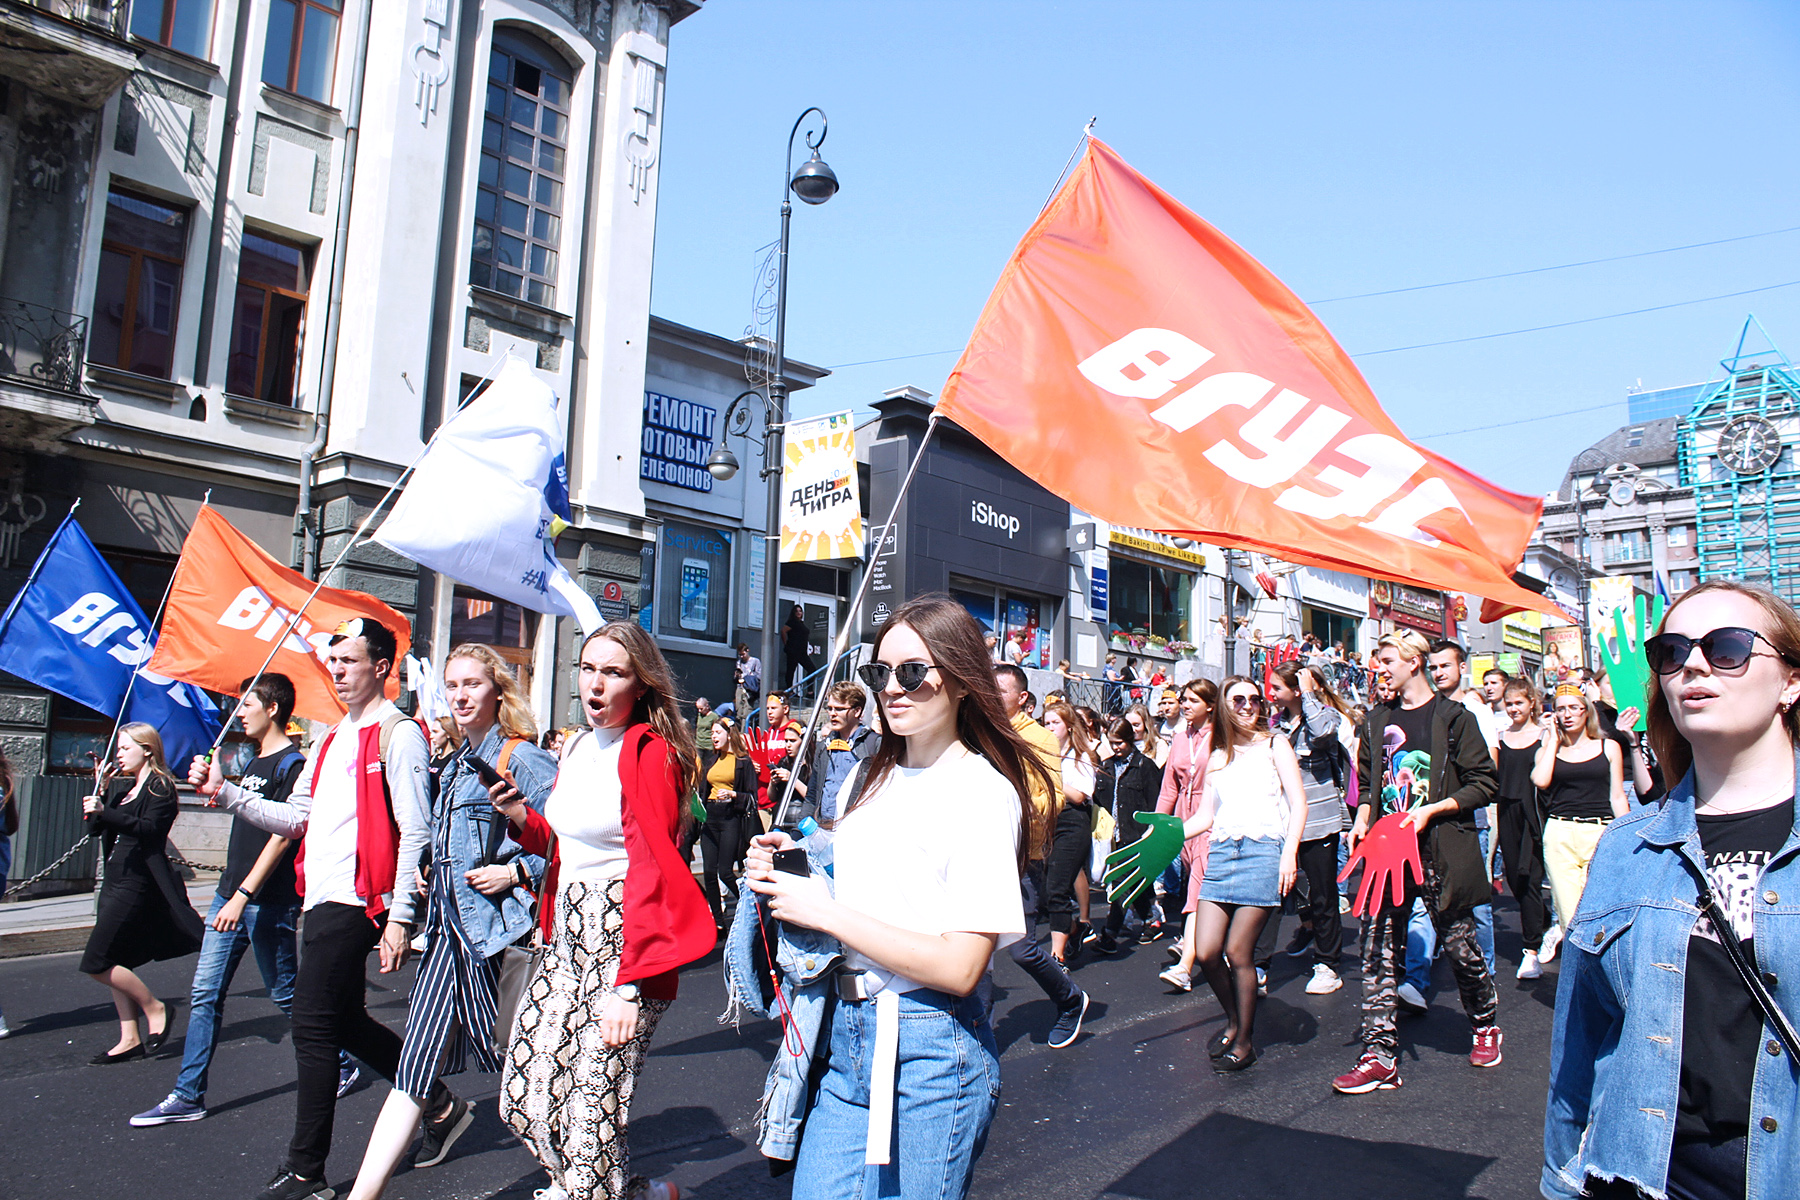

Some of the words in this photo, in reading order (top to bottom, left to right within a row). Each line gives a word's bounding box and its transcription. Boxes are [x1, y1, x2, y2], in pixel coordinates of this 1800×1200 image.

[643, 426, 712, 466] ОТОВЫХ
[641, 456, 712, 491] ЕЛЕФОНОВ
[789, 478, 836, 507] ДЕНЬ
[800, 487, 853, 516] ТИГРА
[971, 500, 1020, 539] iShop
[664, 528, 723, 556] Service
[1128, 536, 1151, 550] Baking
[1177, 550, 1191, 560] Like
[609, 585, 617, 598] 9
